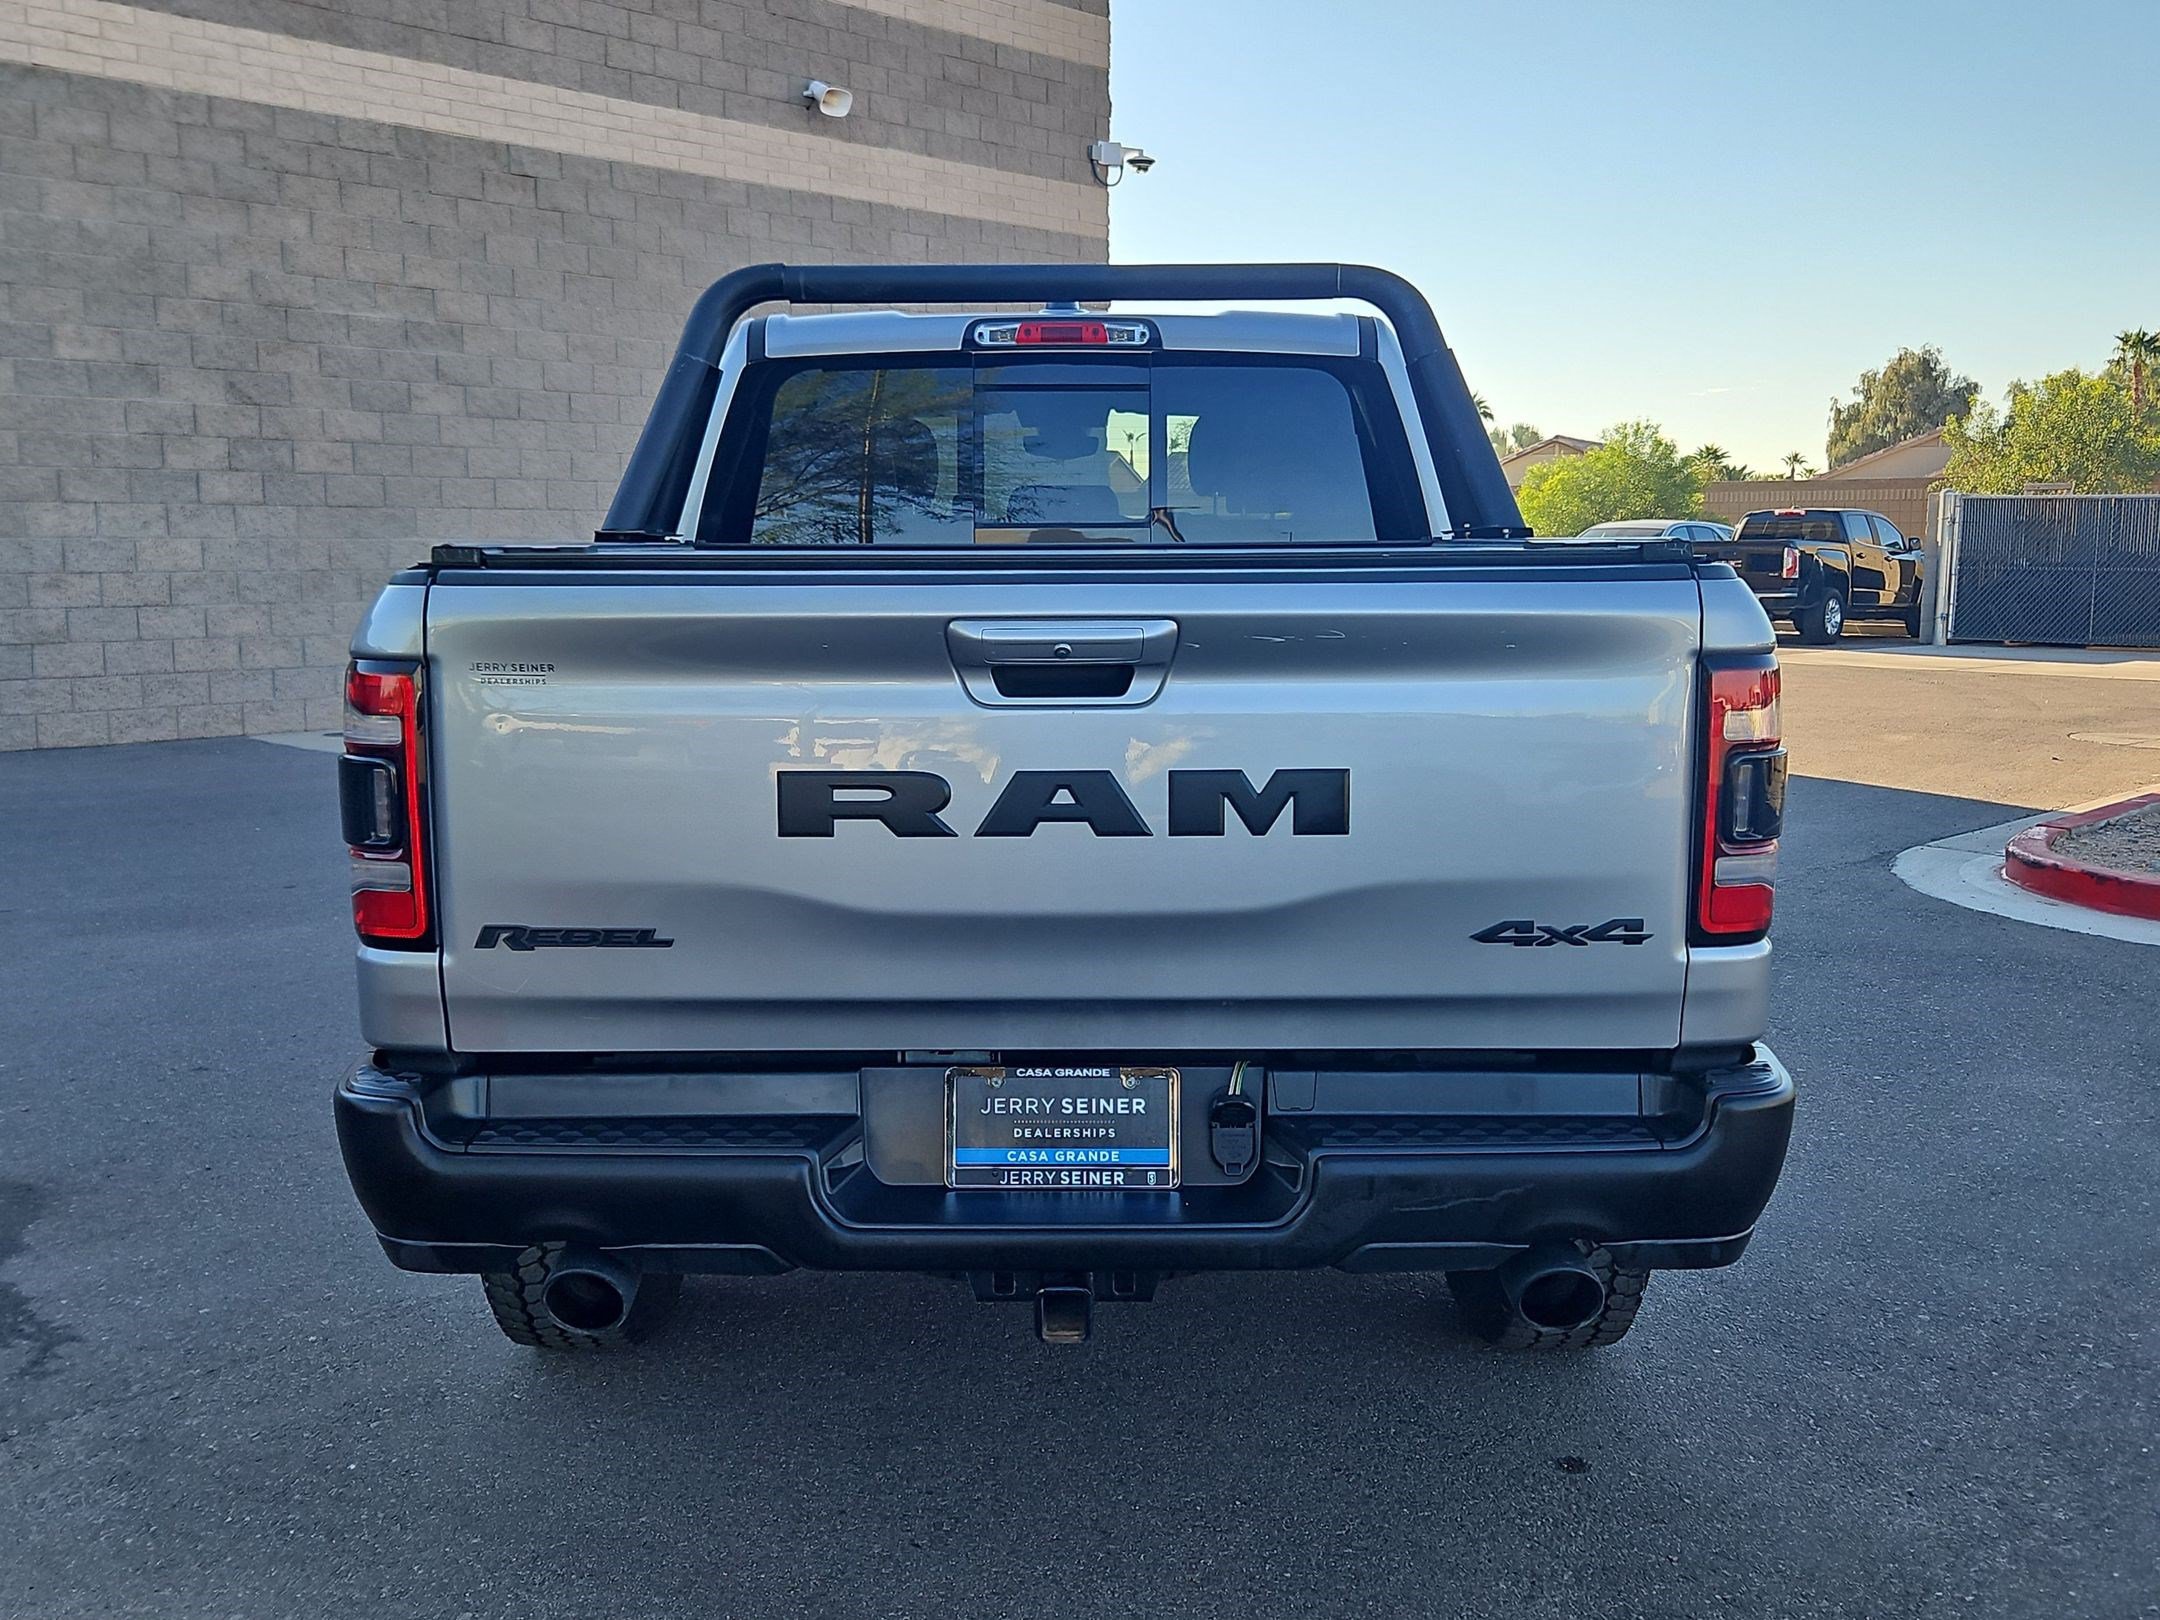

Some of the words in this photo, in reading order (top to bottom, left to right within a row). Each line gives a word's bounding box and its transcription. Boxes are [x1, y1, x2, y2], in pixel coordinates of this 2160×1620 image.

[469, 662, 508, 672] JERRY
[511, 663, 555, 673] SEINER
[480, 677, 547, 685] DEALERSHIPS
[777, 769, 1351, 838] RAM
[474, 924, 675, 951] REBEL
[1016, 1068, 1051, 1077] CASA
[1054, 1068, 1111, 1077] GRANDE
[980, 1097, 1057, 1115] JERRY
[1061, 1097, 1146, 1115] SEINER
[1013, 1128, 1116, 1138] DEALERSHIPS
[1007, 1150, 1049, 1162] CASA
[1055, 1150, 1120, 1162] GRANDE
[999, 1171, 1060, 1185] JERRY
[1060, 1171, 1124, 1185] SEINER
